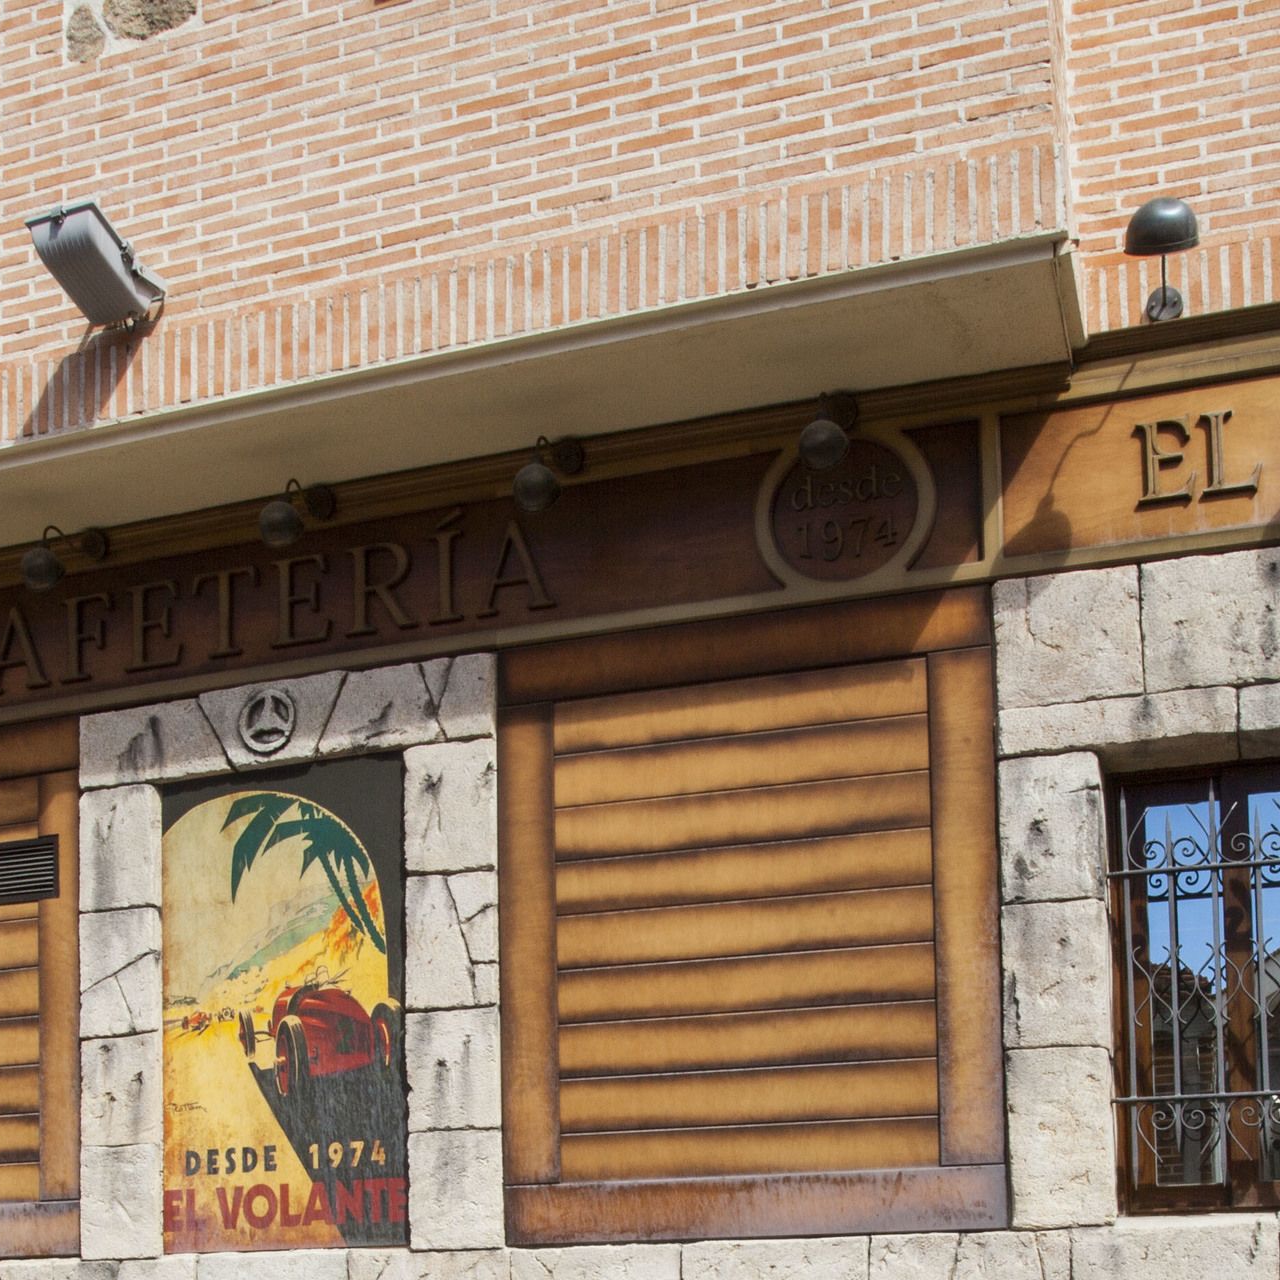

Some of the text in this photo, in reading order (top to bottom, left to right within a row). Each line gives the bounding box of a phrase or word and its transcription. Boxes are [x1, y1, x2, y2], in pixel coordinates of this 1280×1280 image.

[1133, 410, 1262, 510] EL
[790, 464, 903, 512] desde
[797, 516, 899, 562] 1974
[185, 1138, 387, 1177] DESDE 1974
[163, 1177, 408, 1233] EL VOLANTE
